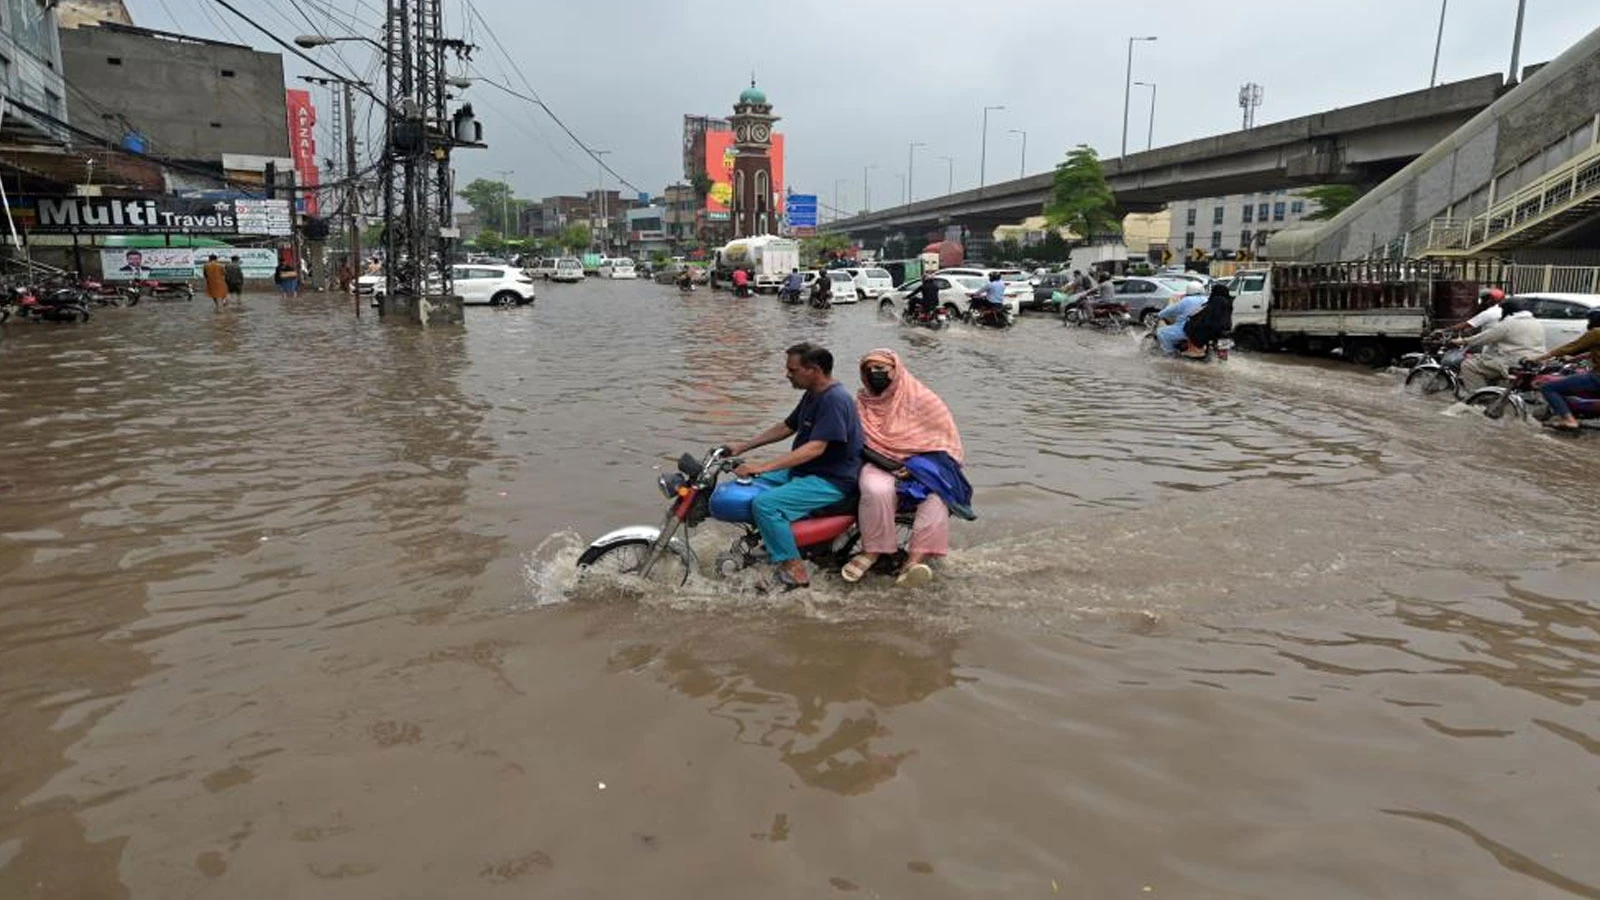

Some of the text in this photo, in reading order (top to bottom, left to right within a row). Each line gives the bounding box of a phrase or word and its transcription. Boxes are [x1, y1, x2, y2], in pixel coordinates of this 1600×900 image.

[298, 107, 310, 158] AFZAL
[38, 199, 157, 225] Multi
[160, 211, 234, 227] Travels
